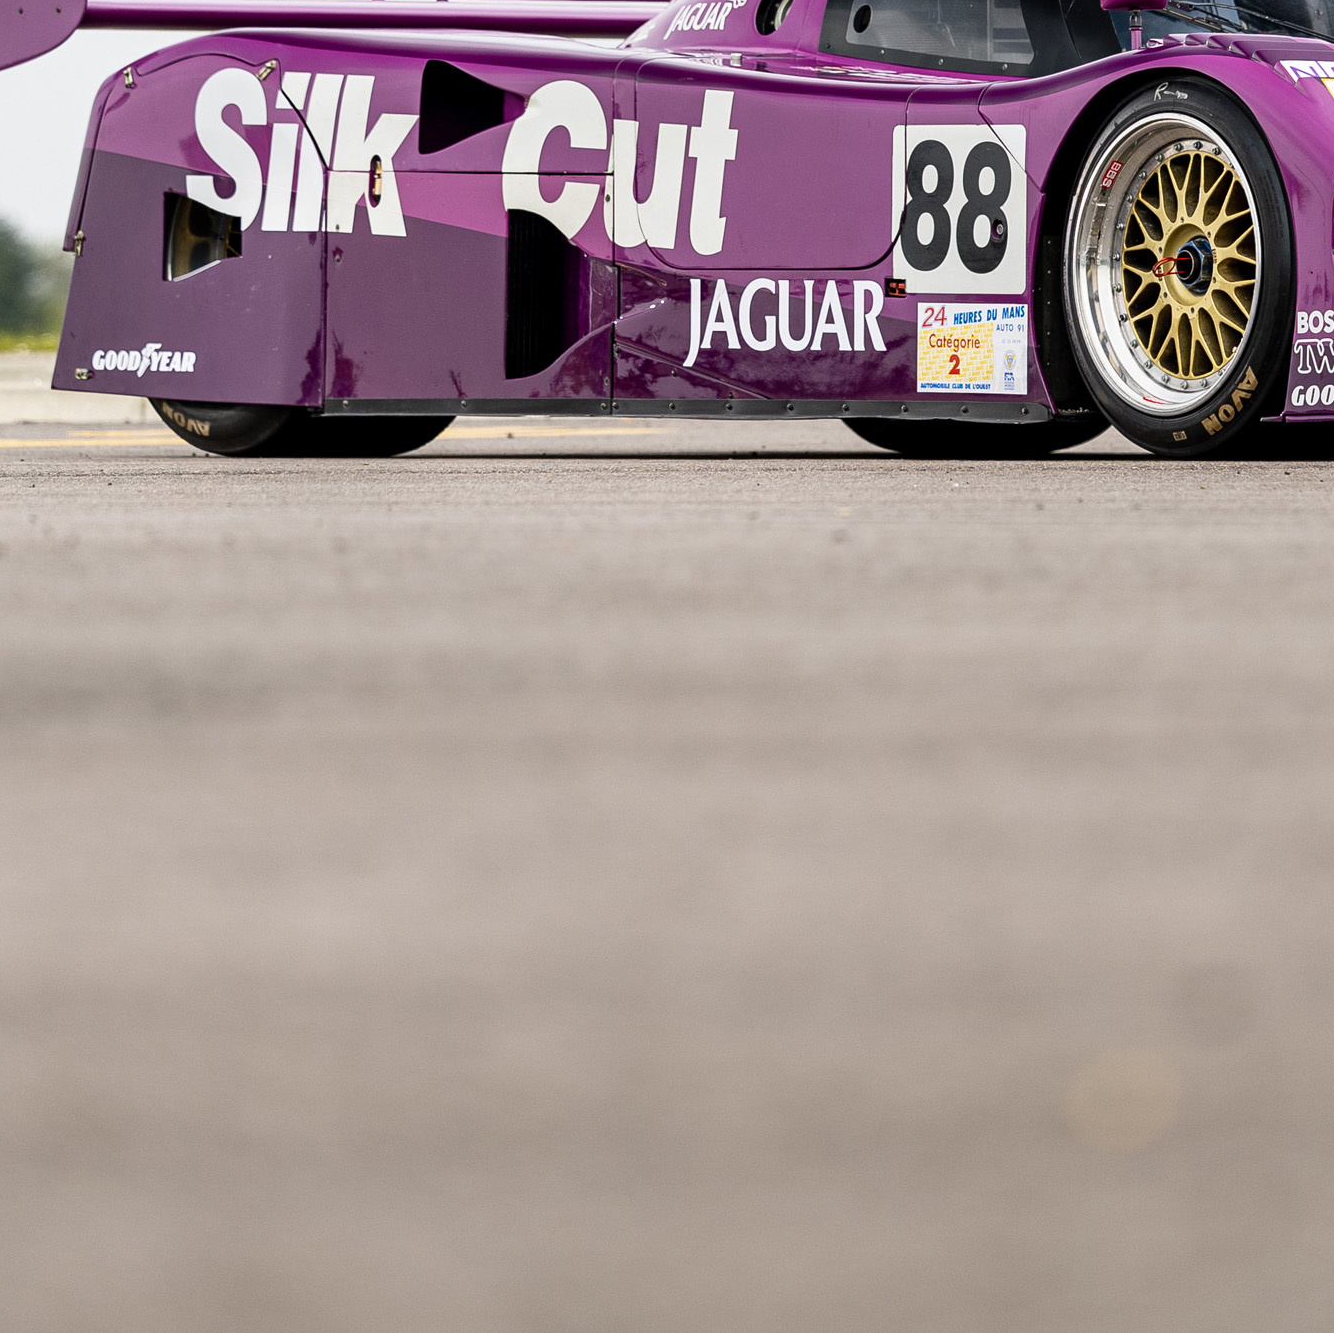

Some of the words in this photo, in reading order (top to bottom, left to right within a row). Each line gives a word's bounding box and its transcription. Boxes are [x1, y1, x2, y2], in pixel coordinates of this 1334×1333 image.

[663, 2, 733, 41] JAGUAR
[186, 67, 420, 238] Silk
[502, 79, 739, 256] Cut
[1101, 161, 1123, 188] BBS
[900, 139, 1012, 274] 88
[682, 277, 887, 368] JAGUAR
[921, 305, 948, 328] 24
[953, 310, 983, 325] HEURES
[986, 308, 998, 322] DU
[1001, 305, 1025, 320] MANS
[995, 323, 1014, 332] AUTO
[1017, 323, 1025, 333] 91
[928, 333, 981, 353] Catégorie
[92, 346, 197, 374] GOODYEAR
[948, 354, 961, 375] 2
[1201, 365, 1259, 436] AVON
